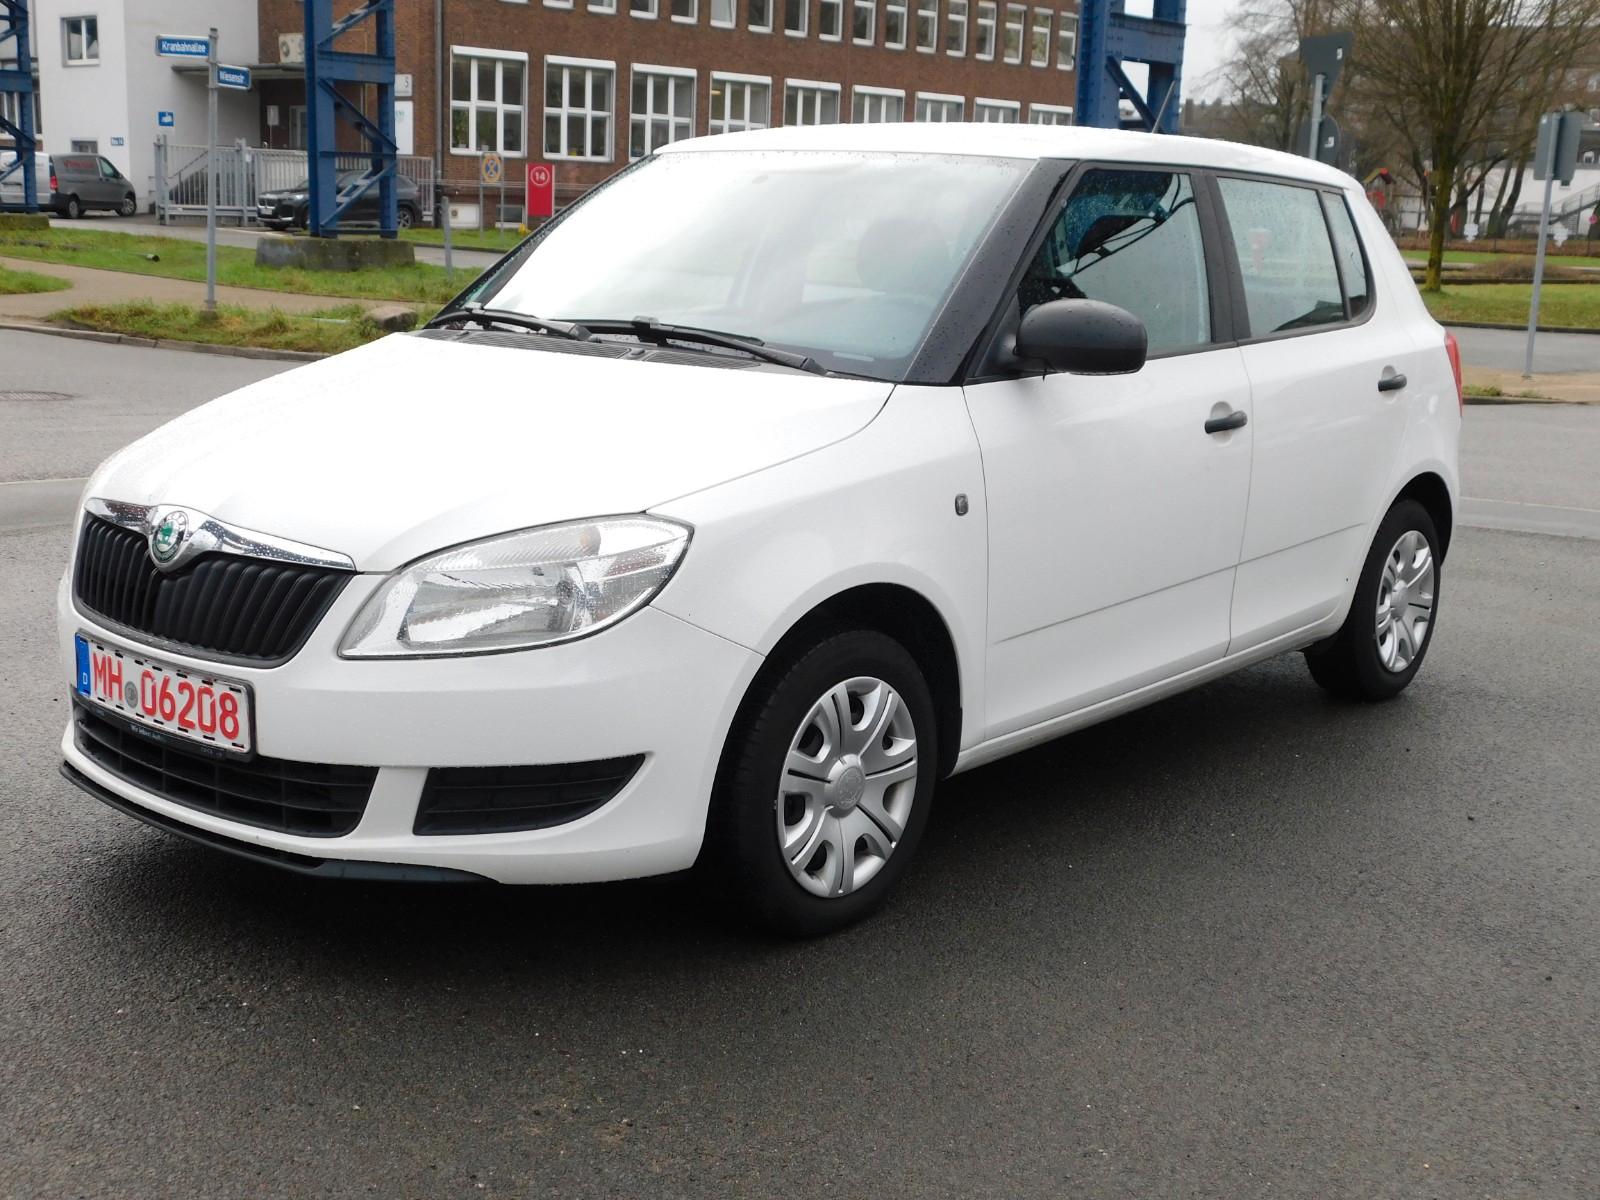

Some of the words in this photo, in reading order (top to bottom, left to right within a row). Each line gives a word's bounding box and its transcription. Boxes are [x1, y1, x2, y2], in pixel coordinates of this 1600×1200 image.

[161, 41, 206, 53] Kranbahnallee
[535, 171, 546, 181] 14
[82, 672, 88, 685] D
[92, 652, 124, 700] MH
[141, 669, 240, 740] 06208
